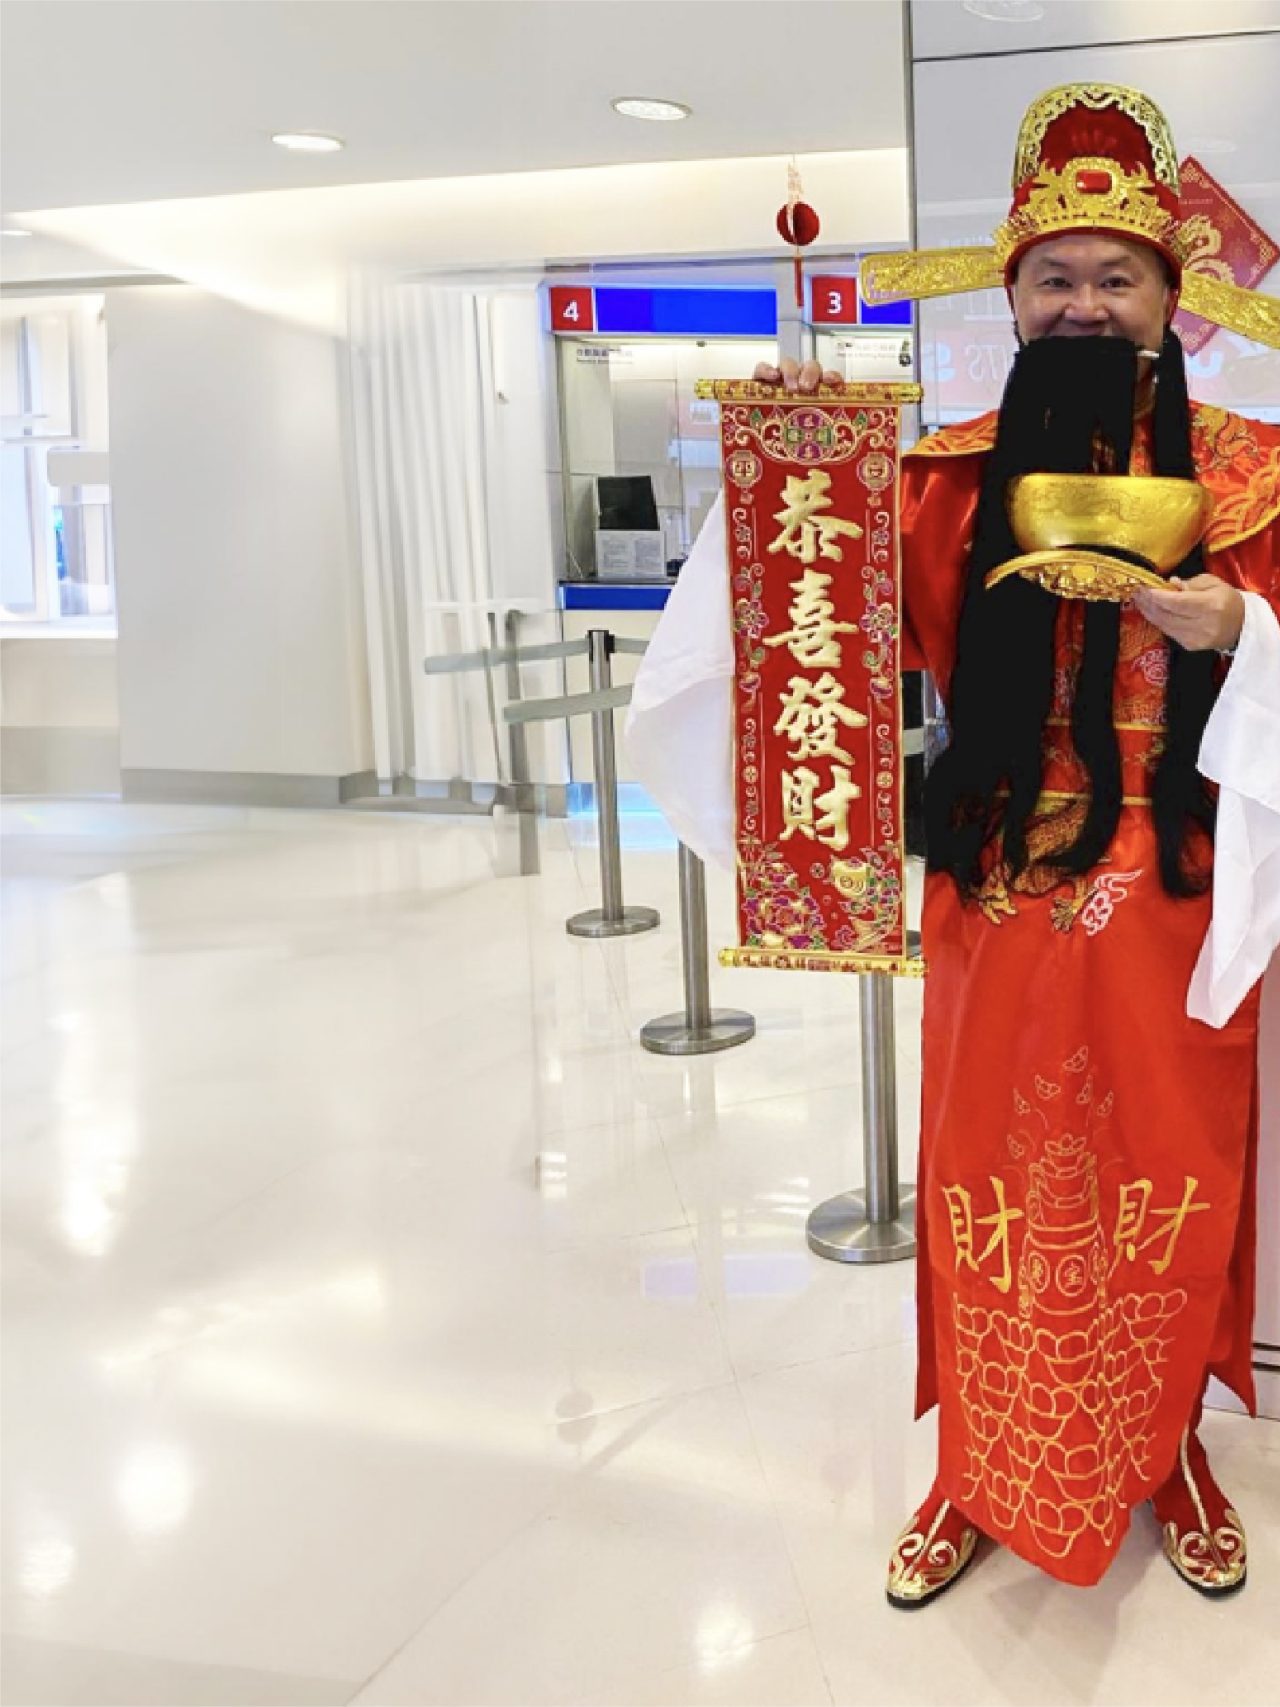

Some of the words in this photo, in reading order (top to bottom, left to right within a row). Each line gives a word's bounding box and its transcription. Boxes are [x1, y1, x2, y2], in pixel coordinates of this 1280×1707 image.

[562, 300, 579, 321] 4
[827, 291, 842, 314] 3
[764, 469, 868, 849] 恭喜發財
[942, 1176, 1024, 1293] 財
[1113, 1176, 1211, 1275] 財
